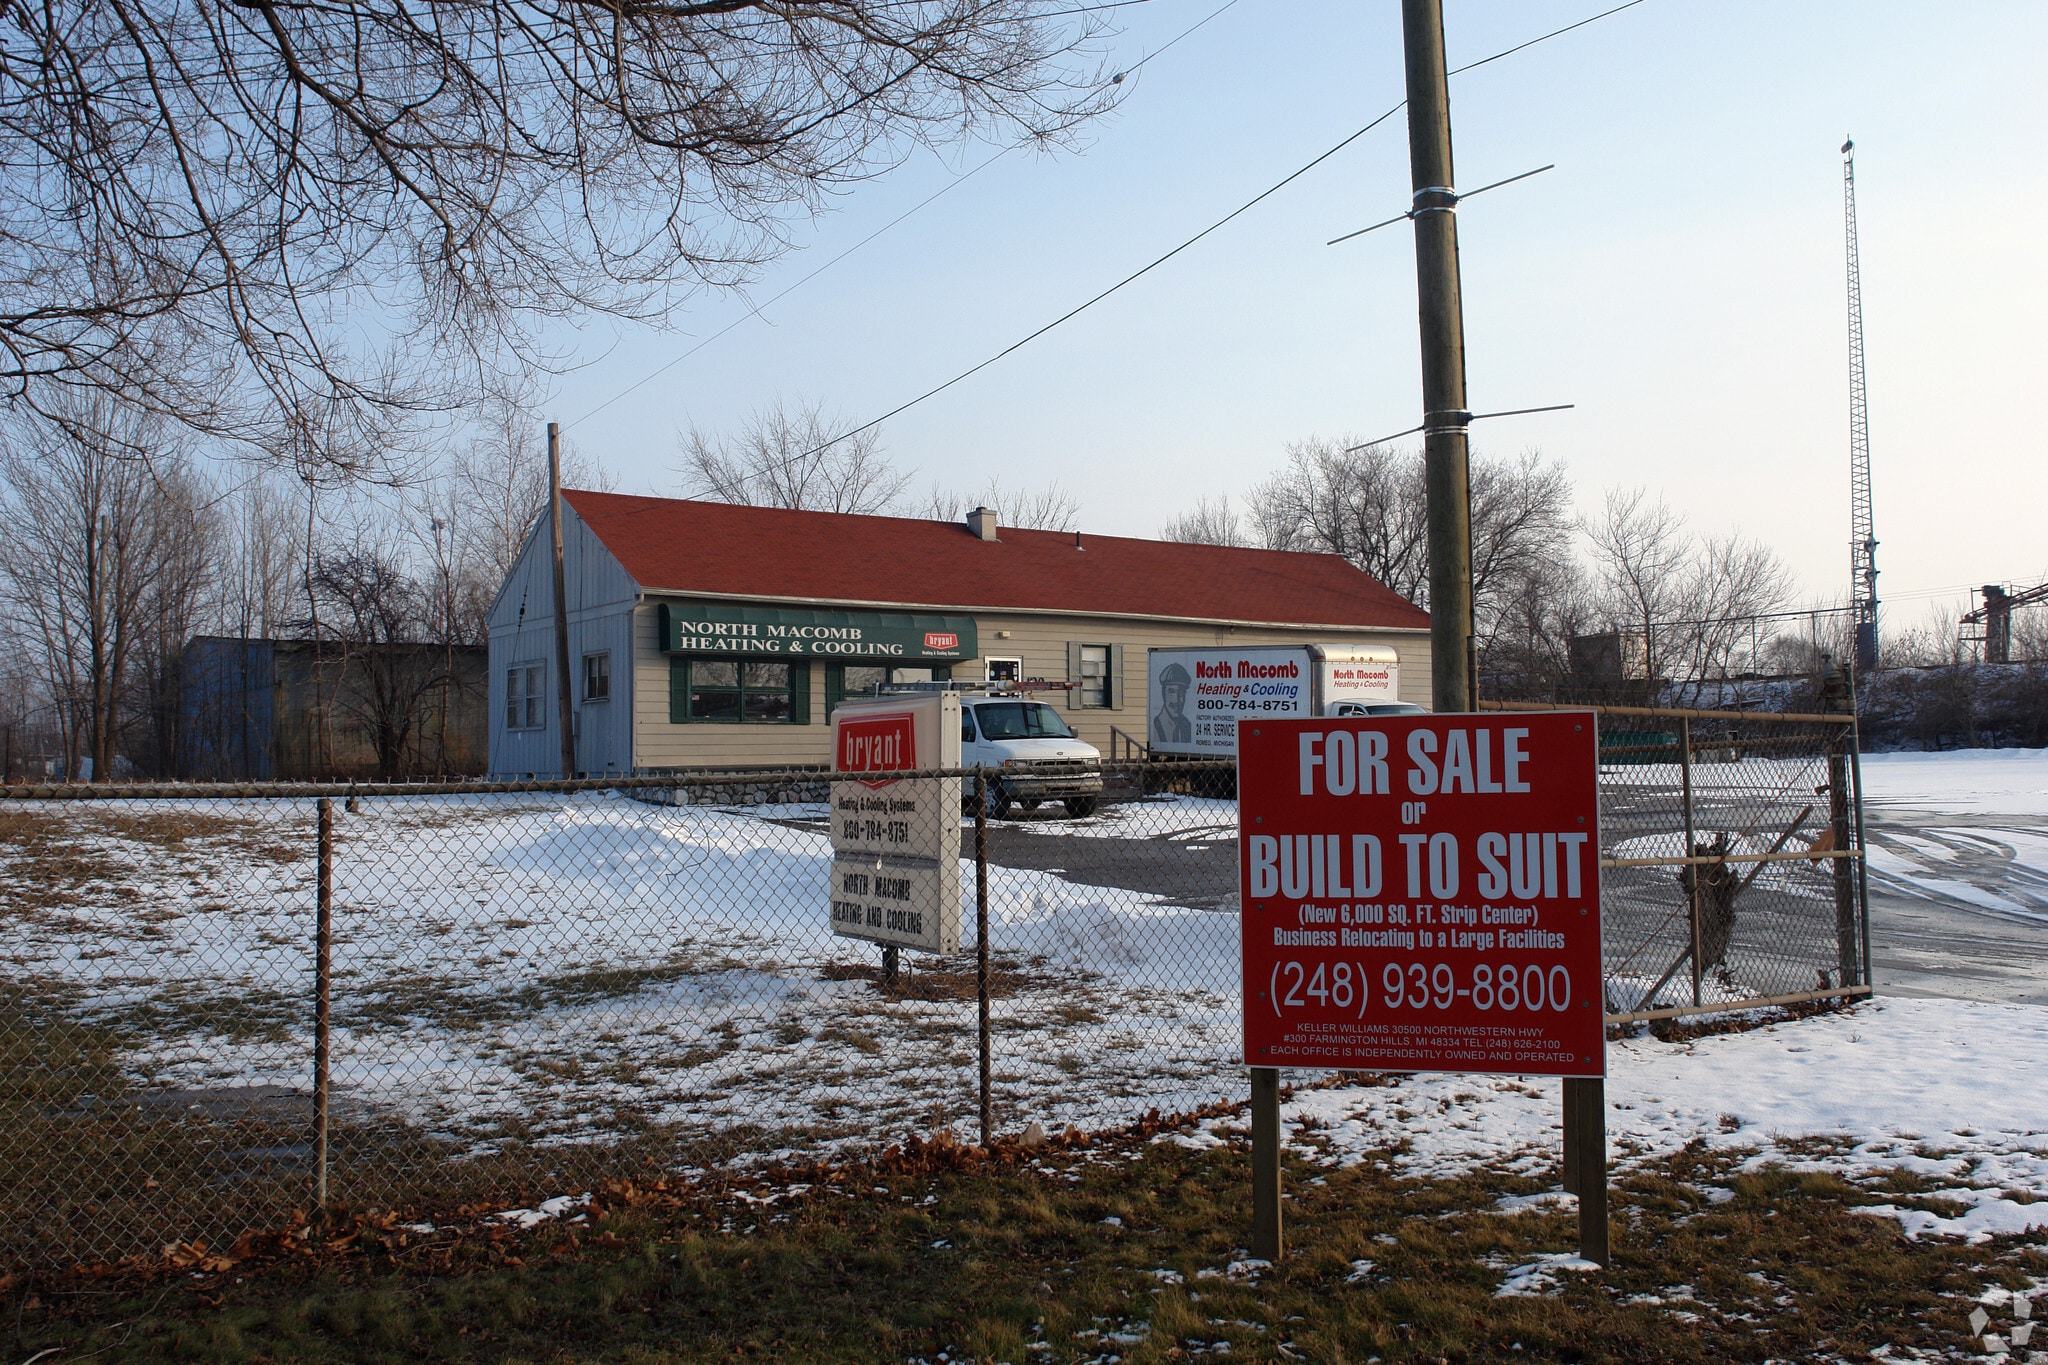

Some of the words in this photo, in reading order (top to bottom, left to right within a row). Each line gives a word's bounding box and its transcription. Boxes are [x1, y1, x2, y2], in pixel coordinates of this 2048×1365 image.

[680, 621, 757, 636] NORTH
[767, 625, 862, 640] MACOMB
[680, 637, 780, 652] HEATING
[789, 640, 803, 652] &
[811, 641, 904, 656] COOLING
[929, 635, 952, 646] bryant
[1196, 661, 1232, 678] North
[1237, 660, 1299, 678] Macomb
[1333, 669, 1354, 679] North
[1356, 669, 1389, 679] Macomb
[1196, 682, 1242, 699] Heating
[1243, 684, 1249, 693] &
[1250, 682, 1299, 699] Cooling
[1333, 680, 1359, 689] Heating
[1363, 680, 1389, 690] Cooling
[1197, 699, 1298, 711] 800-784-8751
[1195, 723, 1202, 736] 24
[1213, 723, 1235, 737] SERVICE
[846, 729, 901, 770] bryant
[1299, 730, 1391, 797] FOR
[1406, 727, 1531, 796] SALE
[838, 796, 859, 814] Heating
[860, 797, 865, 811] &
[866, 797, 888, 815] Cooling
[889, 798, 915, 815] Systems
[1401, 801, 1426, 825] or
[1249, 834, 1382, 899] BUILD
[1399, 832, 1459, 899] TO
[1477, 831, 1588, 899] SUIT
[843, 872, 869, 896] NORTH
[875, 876, 911, 901] MACOMB
[833, 900, 862, 925] HEATING
[866, 906, 882, 927] AND
[886, 909, 922, 934] COOLING
[1298, 904, 1337, 925] (New
[1340, 904, 1384, 926] 6,000
[1387, 904, 1412, 926] SQ.
[1416, 904, 1437, 924] FT.
[1441, 904, 1478, 927] Strip
[1481, 904, 1539, 927] Center)
[1273, 927, 1337, 947] Business
[1341, 927, 1415, 950] Relocating
[1418, 929, 1433, 948] to
[1437, 931, 1447, 948] a
[1451, 928, 1494, 951] Large
[1498, 928, 1565, 949] Facilities
[1270, 961, 1368, 1019] (248)
[1383, 962, 1571, 1012] 939-8800
[1297, 1023, 1337, 1033] KELLER
[1339, 1024, 1389, 1034] WILLIAMS
[1392, 1025, 1422, 1035] 30500
[1424, 1026, 1516, 1037] NORTHWESTERN
[1518, 1028, 1544, 1037] HWY
[1283, 1034, 1307, 1043] #300
[1309, 1035, 1378, 1045] FARMINGTON
[1415, 1037, 1428, 1046] MI
[1430, 1038, 1460, 1047] 48334
[1485, 1039, 1512, 1050] (248)
[1513, 1039, 1561, 1050] 626-2100
[1270, 1046, 1299, 1055] EACH
[1301, 1046, 1339, 1057] OFFICE
[1342, 1047, 1352, 1057] IS
[1354, 1048, 1442, 1059] INDEPENDENTLY
[1444, 1050, 1487, 1060] OWNED
[1488, 1051, 1512, 1061] AND
[1514, 1052, 1575, 1062] OPERATED
